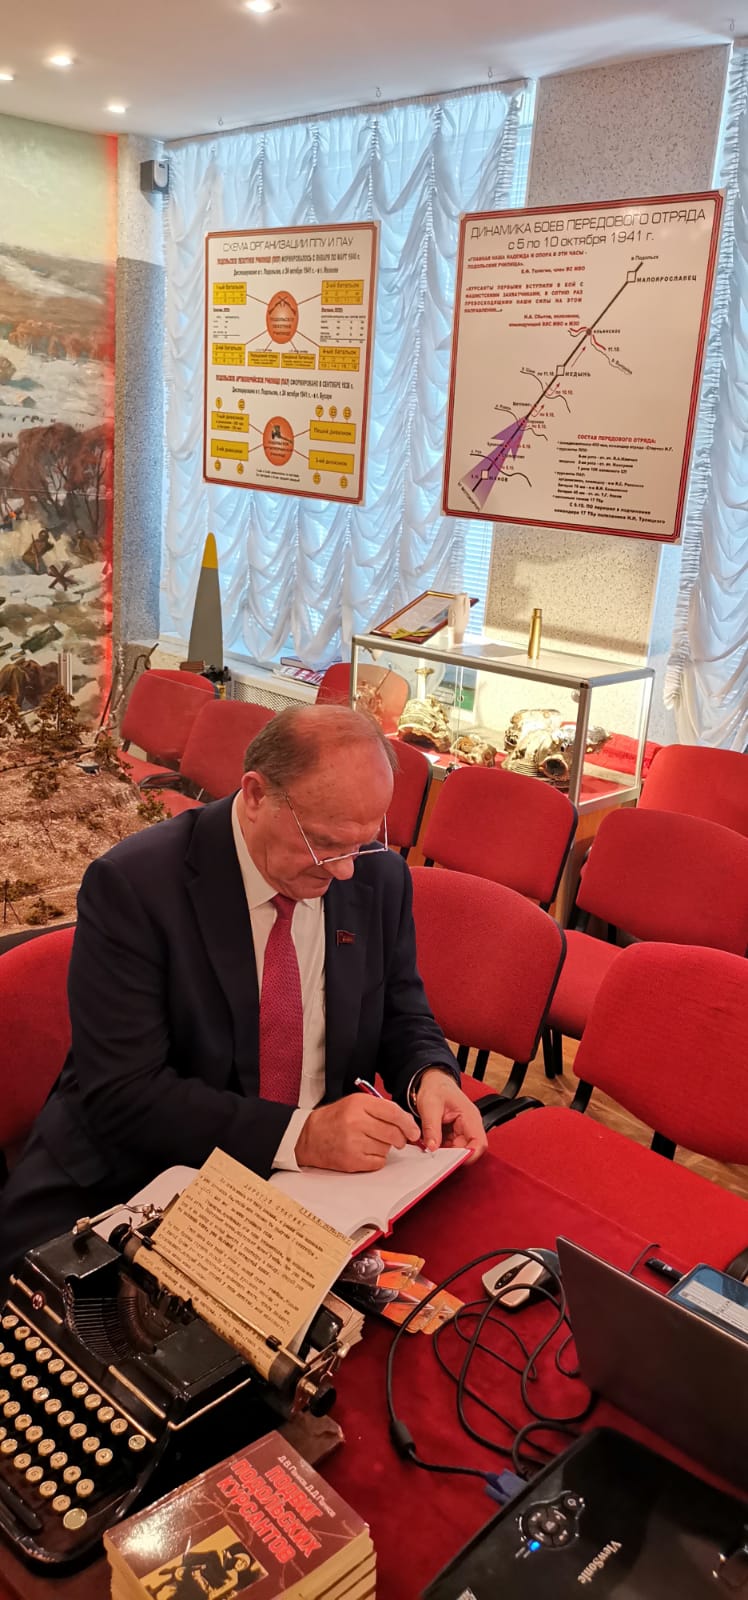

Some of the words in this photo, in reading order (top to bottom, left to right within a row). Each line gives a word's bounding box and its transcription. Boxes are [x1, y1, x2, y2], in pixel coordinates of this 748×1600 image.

[250, 239, 309, 251] ОРГАНИЗАЦИИ
[328, 238, 334, 248] И
[336, 237, 354, 247] ПАУ
[471, 223, 531, 239] ДИНАМИКА
[534, 221, 564, 234] БОЕВ
[566, 213, 648, 231] ПЕРЕДОВОГО
[651, 208, 706, 224] ОТРЯДА
[508, 242, 515, 250] с
[516, 239, 525, 250] 5
[526, 240, 540, 249] по
[545, 236, 558, 247] 10
[561, 234, 606, 247] октября
[611, 230, 641, 243] 1941
[646, 232, 654, 241] г.
[230, 1458, 322, 1559] ПОДОЛЬСКИХ
[264, 1464, 324, 1522] ПОДВИГ
[216, 1474, 296, 1565] КУРСАНТОВ
[577, 1540, 623, 1584] ViewSonic
